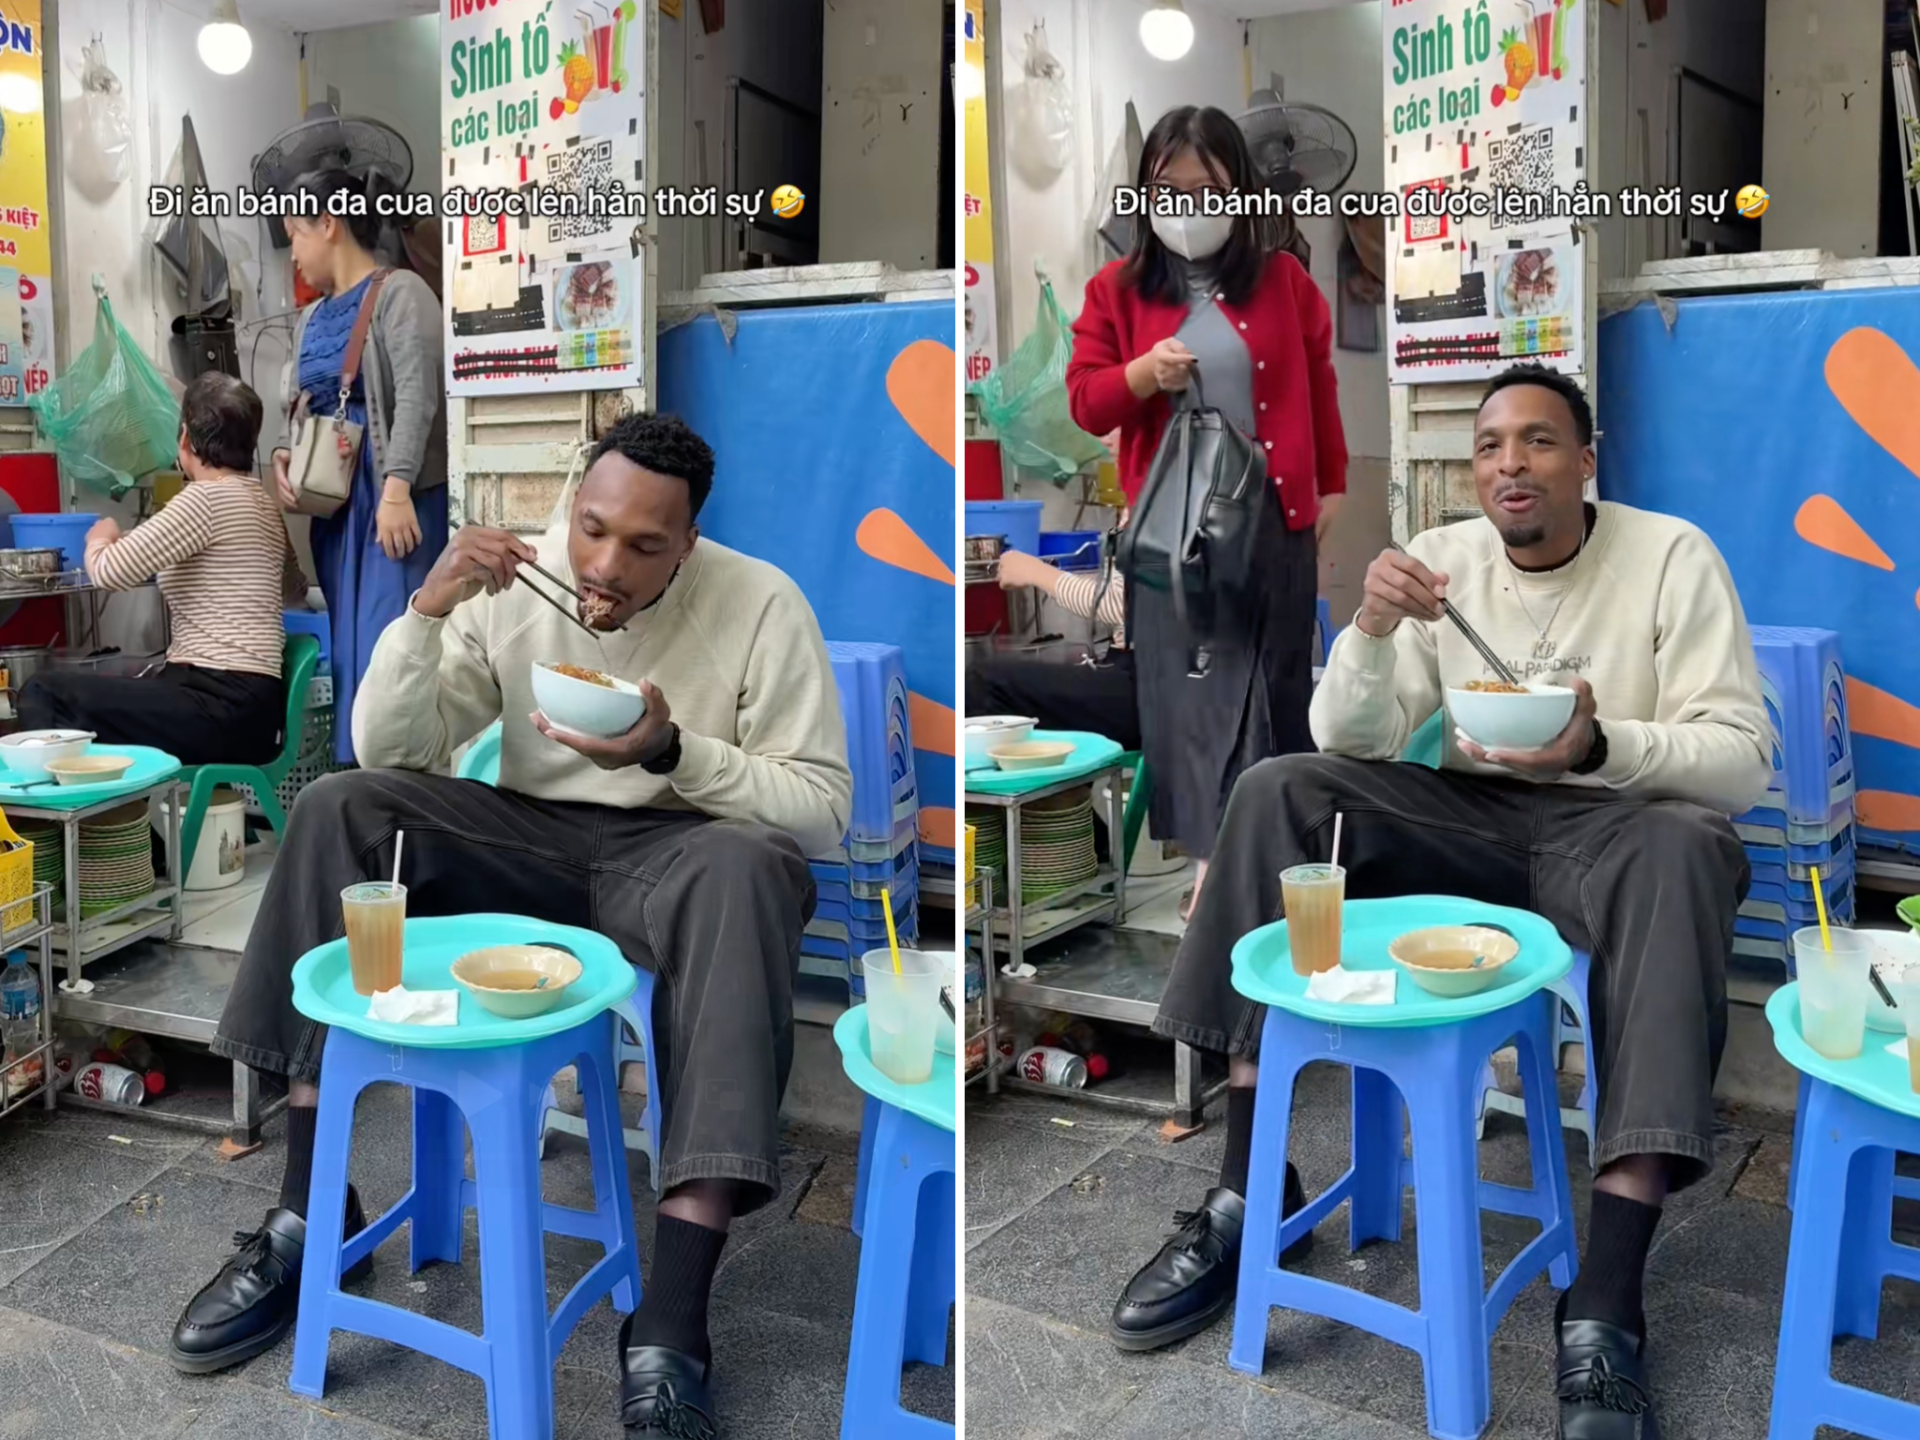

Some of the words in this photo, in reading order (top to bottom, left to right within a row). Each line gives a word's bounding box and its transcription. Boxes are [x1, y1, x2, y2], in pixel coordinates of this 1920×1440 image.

[451, 27, 511, 99] Sinh
[522, 1, 553, 79] tố
[1393, 14, 1453, 85] Sinh
[451, 106, 489, 148] các
[497, 90, 539, 139] loại
[1393, 94, 1431, 134] các
[1439, 77, 1480, 126] loại
[6, 206, 39, 230] KIỆT
